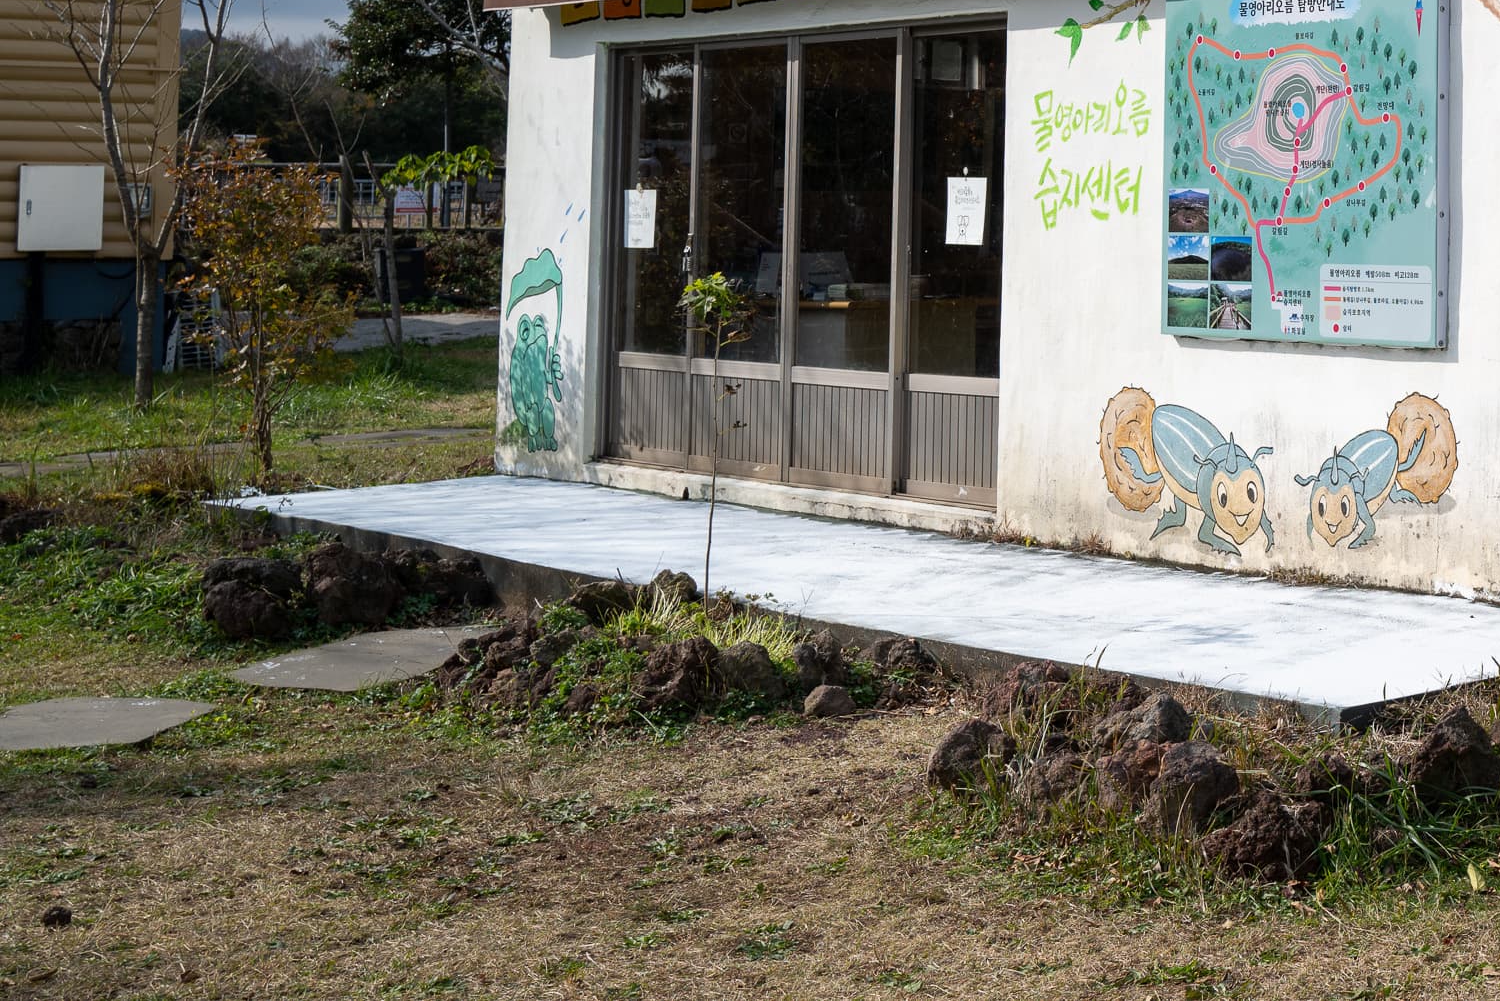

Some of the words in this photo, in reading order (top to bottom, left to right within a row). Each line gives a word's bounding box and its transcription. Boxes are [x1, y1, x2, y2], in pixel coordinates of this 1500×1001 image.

[1353, 83, 1370, 93] 갈림길
[1377, 102, 1395, 111] 전망대
[1031, 79, 1152, 152] 물영아리오름
[1034, 157, 1142, 231] 습지센터
[1346, 199, 1366, 207] 삼나무길
[1272, 226, 1288, 236] 갈림길
[1330, 268, 1361, 278] 물영아리오름
[1300, 313, 1315, 322] 주차장
